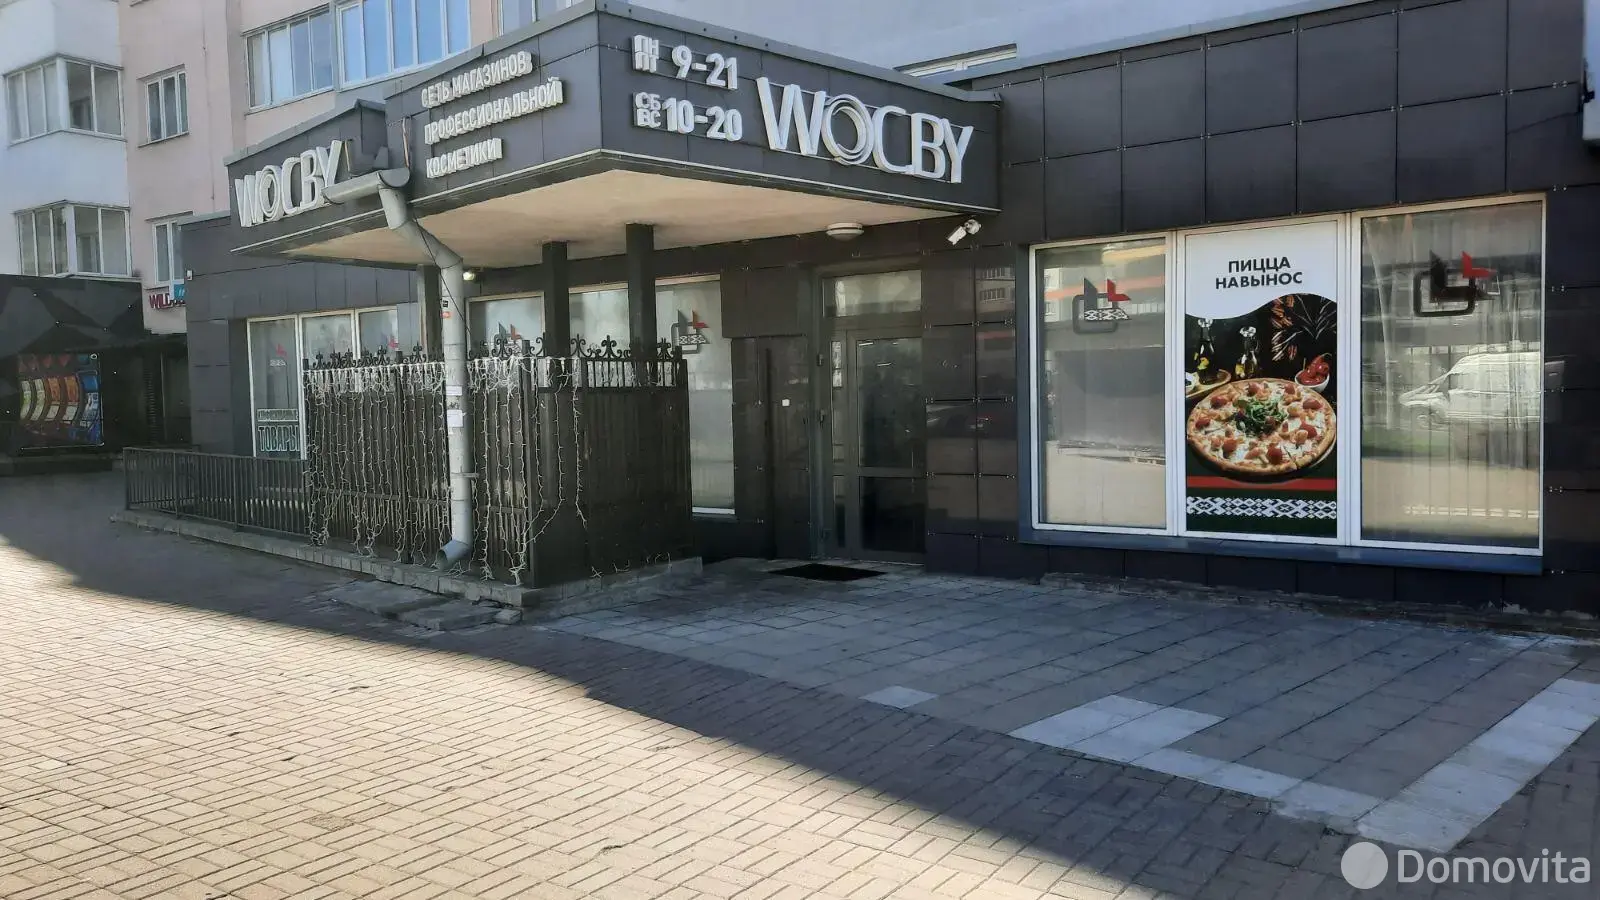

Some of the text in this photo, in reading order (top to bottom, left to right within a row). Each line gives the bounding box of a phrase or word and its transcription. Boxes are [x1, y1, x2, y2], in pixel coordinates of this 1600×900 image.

[632, 34, 659, 59] ПН
[671, 45, 738, 89] 9-21
[421, 50, 533, 109] СЕТЬ МАГАЗИНОВ
[424, 76, 564, 145] ПРОФЕССИОНАЛЬНОЙ
[634, 91, 662, 111] СБ
[634, 108, 662, 129] ВС
[662, 97, 743, 141] 10-20
[756, 76, 974, 184] WOCBY
[425, 137, 503, 179] КОСМЕТИКИ
[234, 139, 342, 228] WOCBY
[1215, 271, 1303, 290] НАВЫНОС
[1228, 256, 1291, 274] ПИЦЦА
[257, 424, 301, 452] ТОВАРЫ
